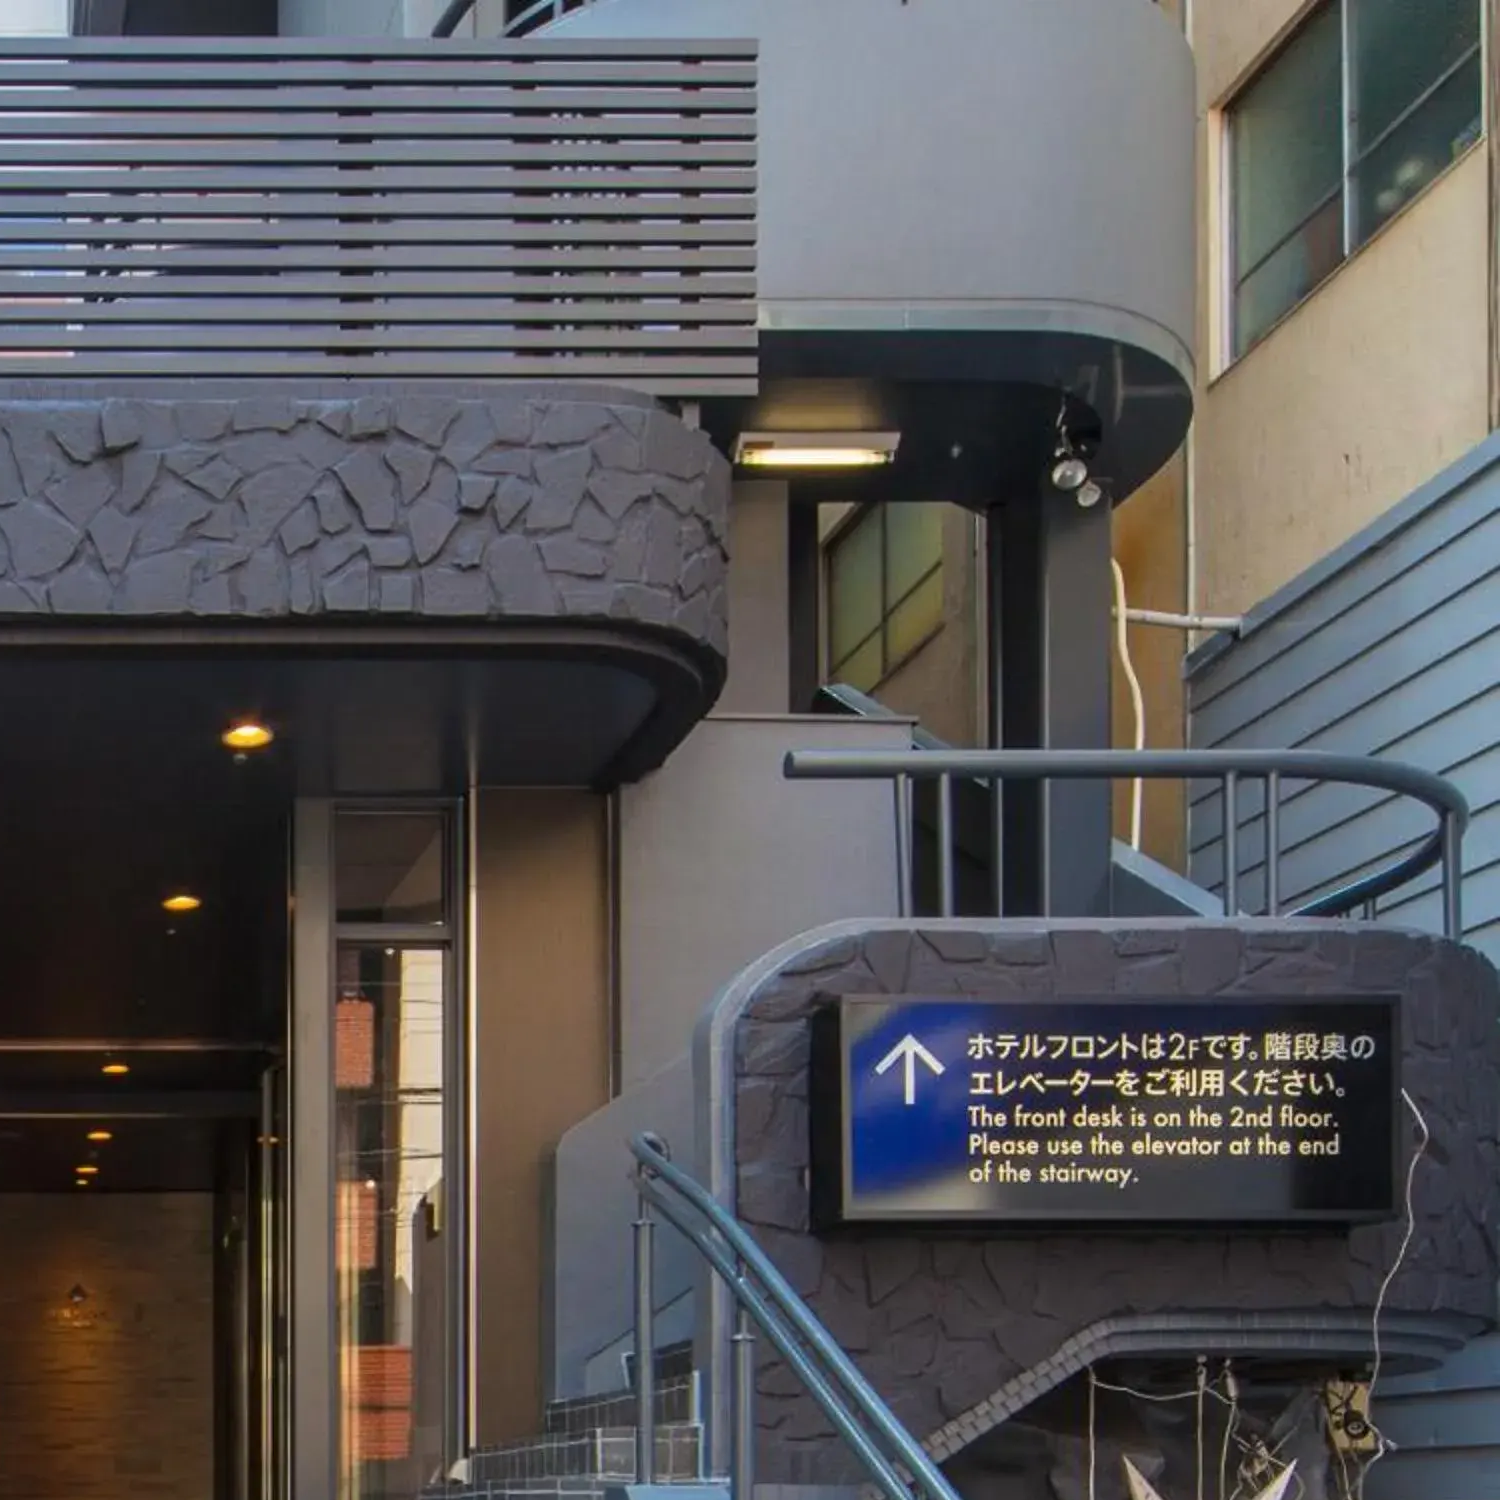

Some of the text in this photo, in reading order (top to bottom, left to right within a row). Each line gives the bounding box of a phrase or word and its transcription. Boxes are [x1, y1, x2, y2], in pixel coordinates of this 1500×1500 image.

[966, 1032, 1376, 1061] ホテルフロントは2Fです。階段奥の
[968, 1068, 1346, 1098] エレベーターをご利用ください。
[967, 1104, 1339, 1128] The front desk is on the 2nd floor.
[969, 1133, 1340, 1156] Please use the elevator at the end
[968, 1161, 1140, 1188] of the stairway.
